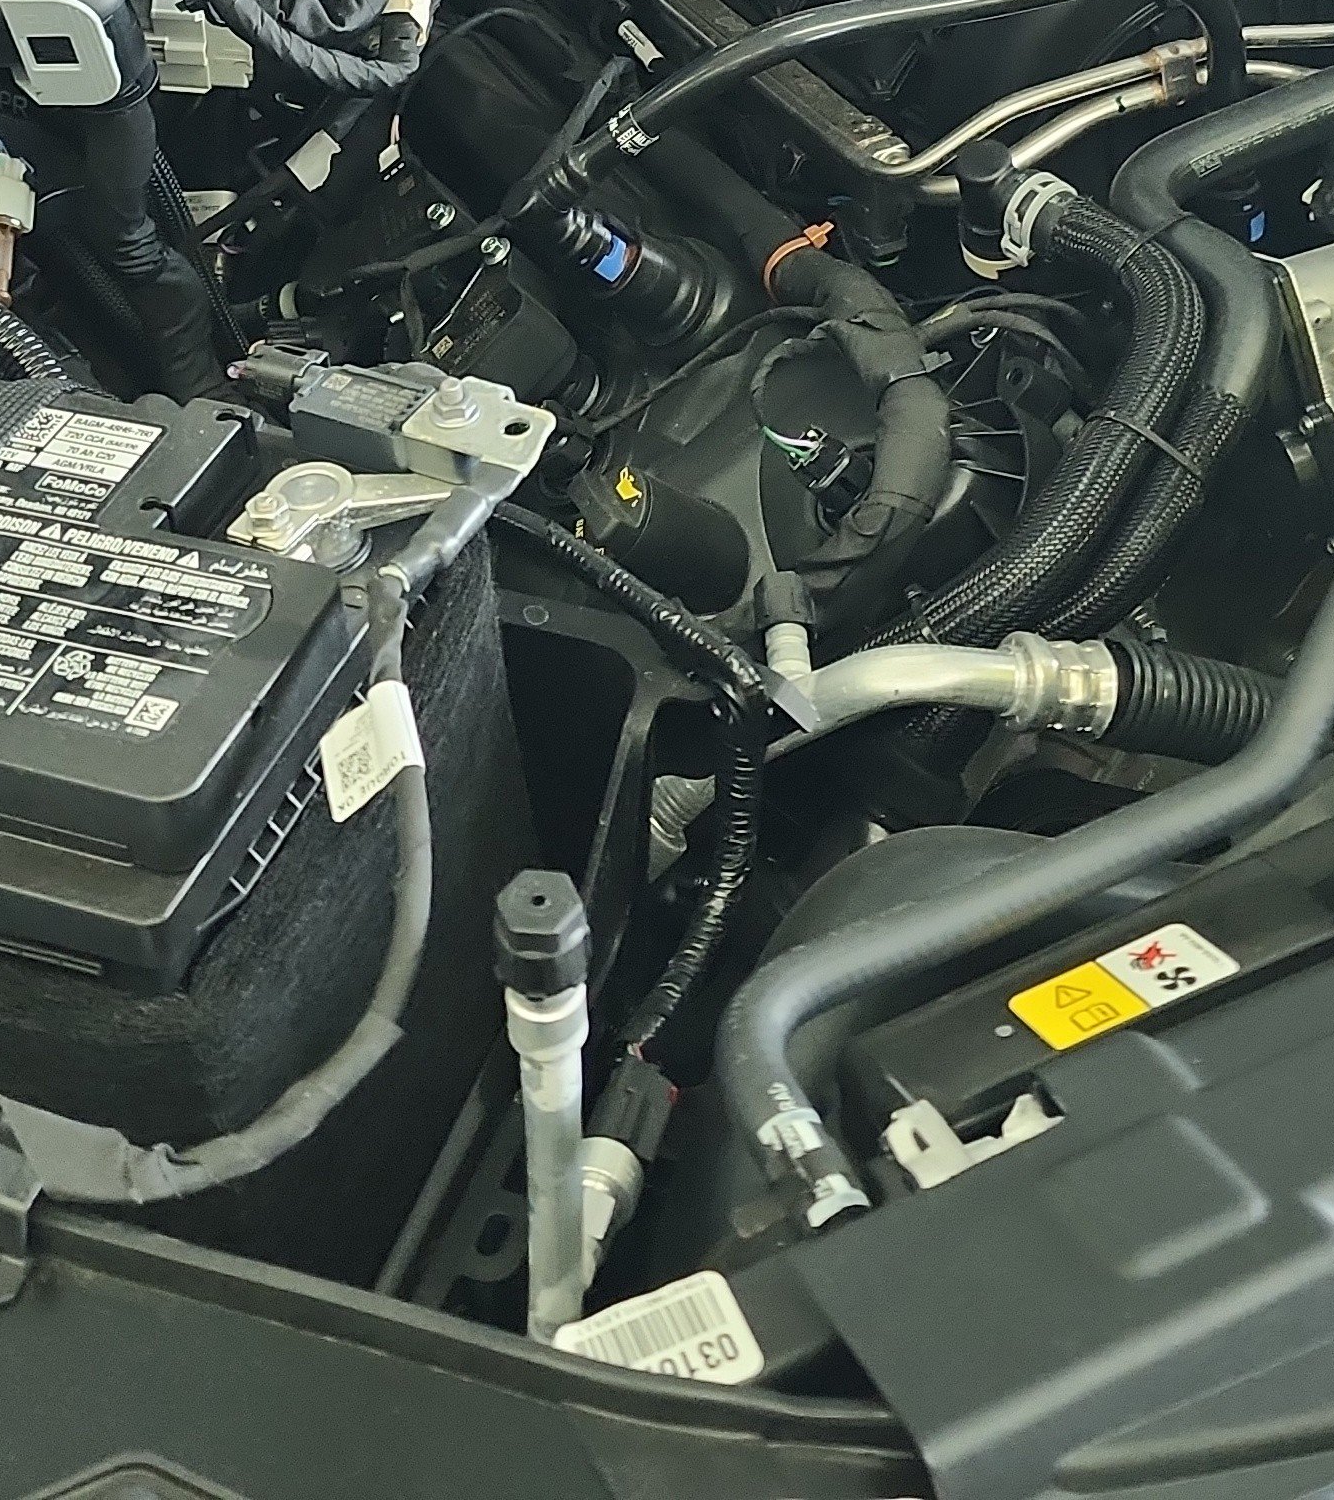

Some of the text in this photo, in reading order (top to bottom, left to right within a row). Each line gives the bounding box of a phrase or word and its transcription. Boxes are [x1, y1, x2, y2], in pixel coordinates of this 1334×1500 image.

[83, 433, 106, 444] CCA
[65, 445, 116, 462] 70 Ah C20
[40, 474, 107, 498] FoMoCo
[62, 527, 180, 563] PELIGRO/VENENO
